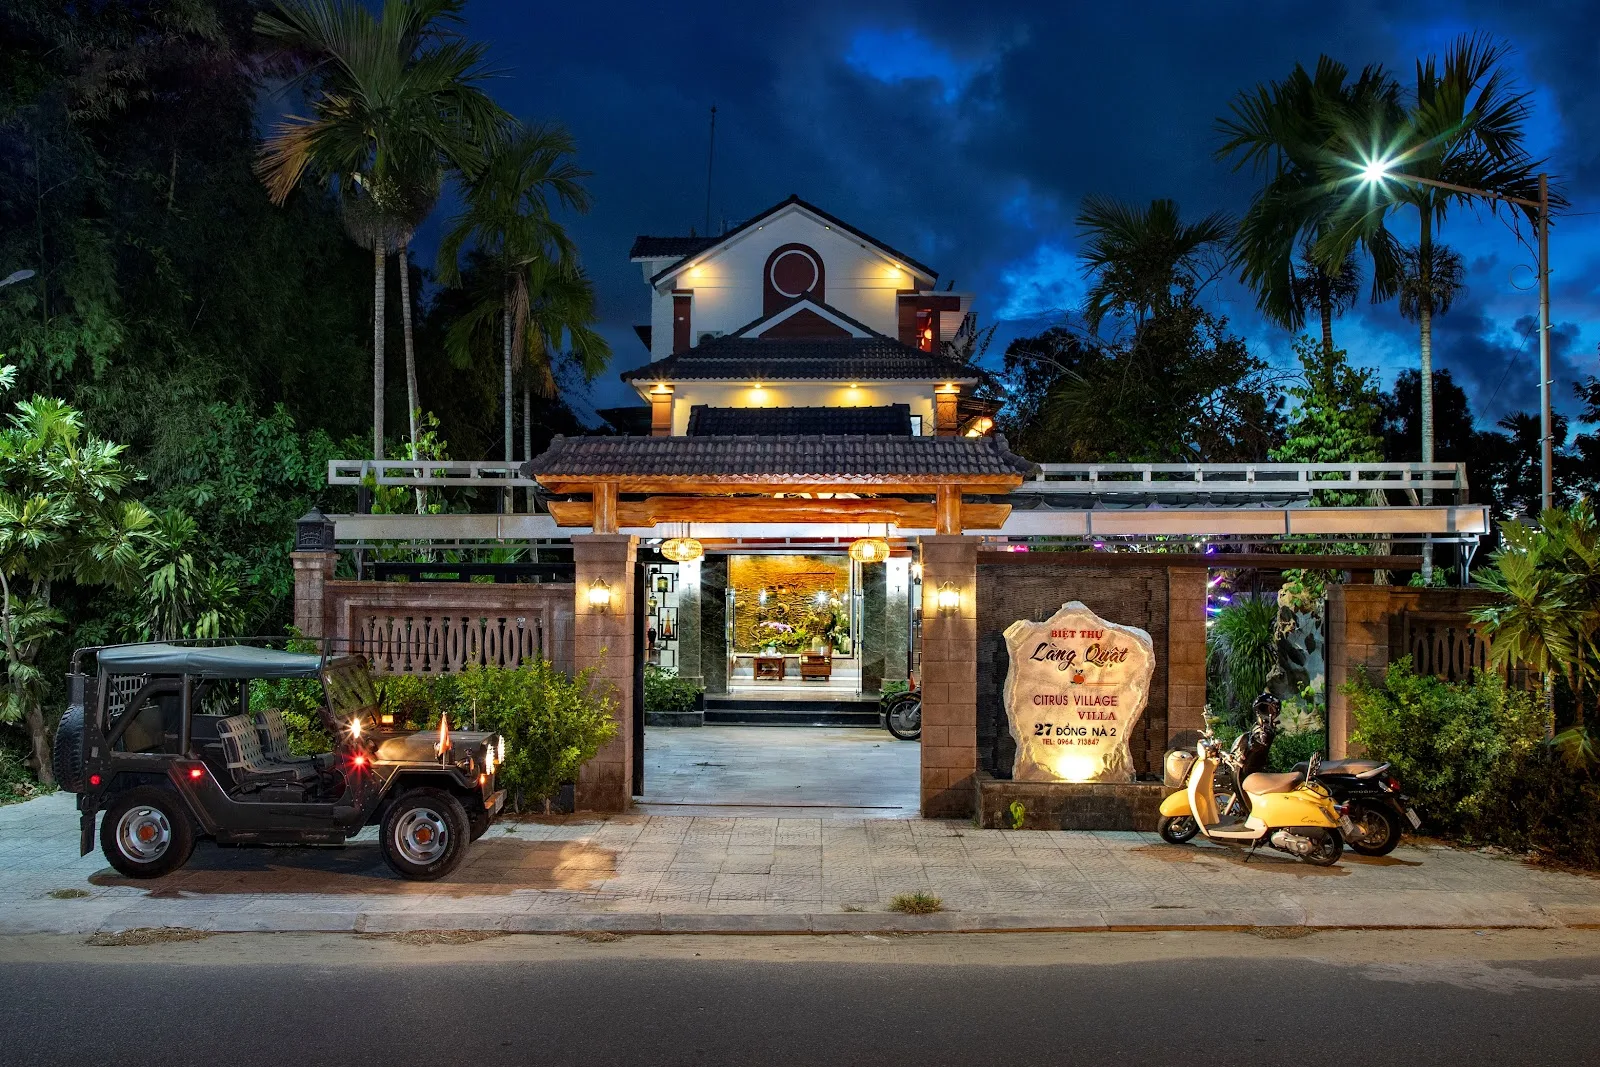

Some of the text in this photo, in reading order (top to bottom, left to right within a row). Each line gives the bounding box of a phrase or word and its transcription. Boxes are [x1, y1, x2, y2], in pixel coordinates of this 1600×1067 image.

[1051, 628, 1104, 640] BIỆT THỰ
[1029, 642, 1129, 671] Làng Quật
[1033, 694, 1118, 706] CITRUS VILLAGE
[1077, 711, 1116, 720] VILLA
[1034, 723, 1053, 736] 27
[1092, 725, 1108, 736] NÀ
[1110, 728, 1117, 736] 2
[1042, 738, 1055, 746] TEL:
[1077, 738, 1100, 746] 713847
